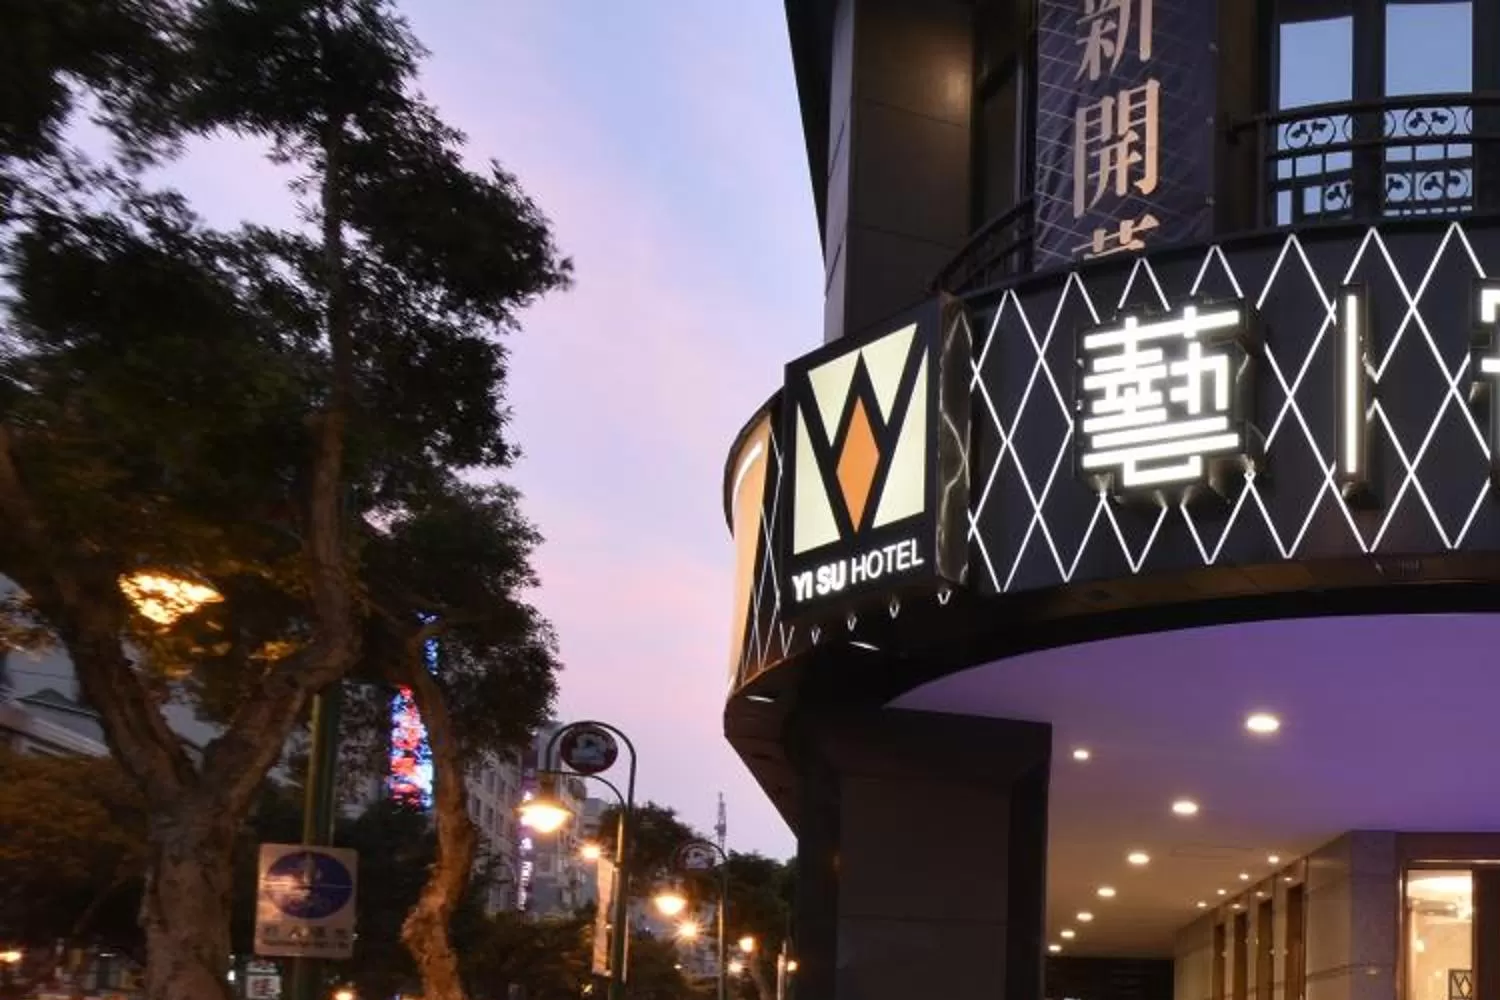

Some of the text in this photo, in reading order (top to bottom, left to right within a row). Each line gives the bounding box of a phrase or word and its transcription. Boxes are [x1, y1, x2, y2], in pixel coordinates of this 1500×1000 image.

[1072, 0, 1160, 261] 新開
[791, 538, 925, 602] YI SU HOTEL
